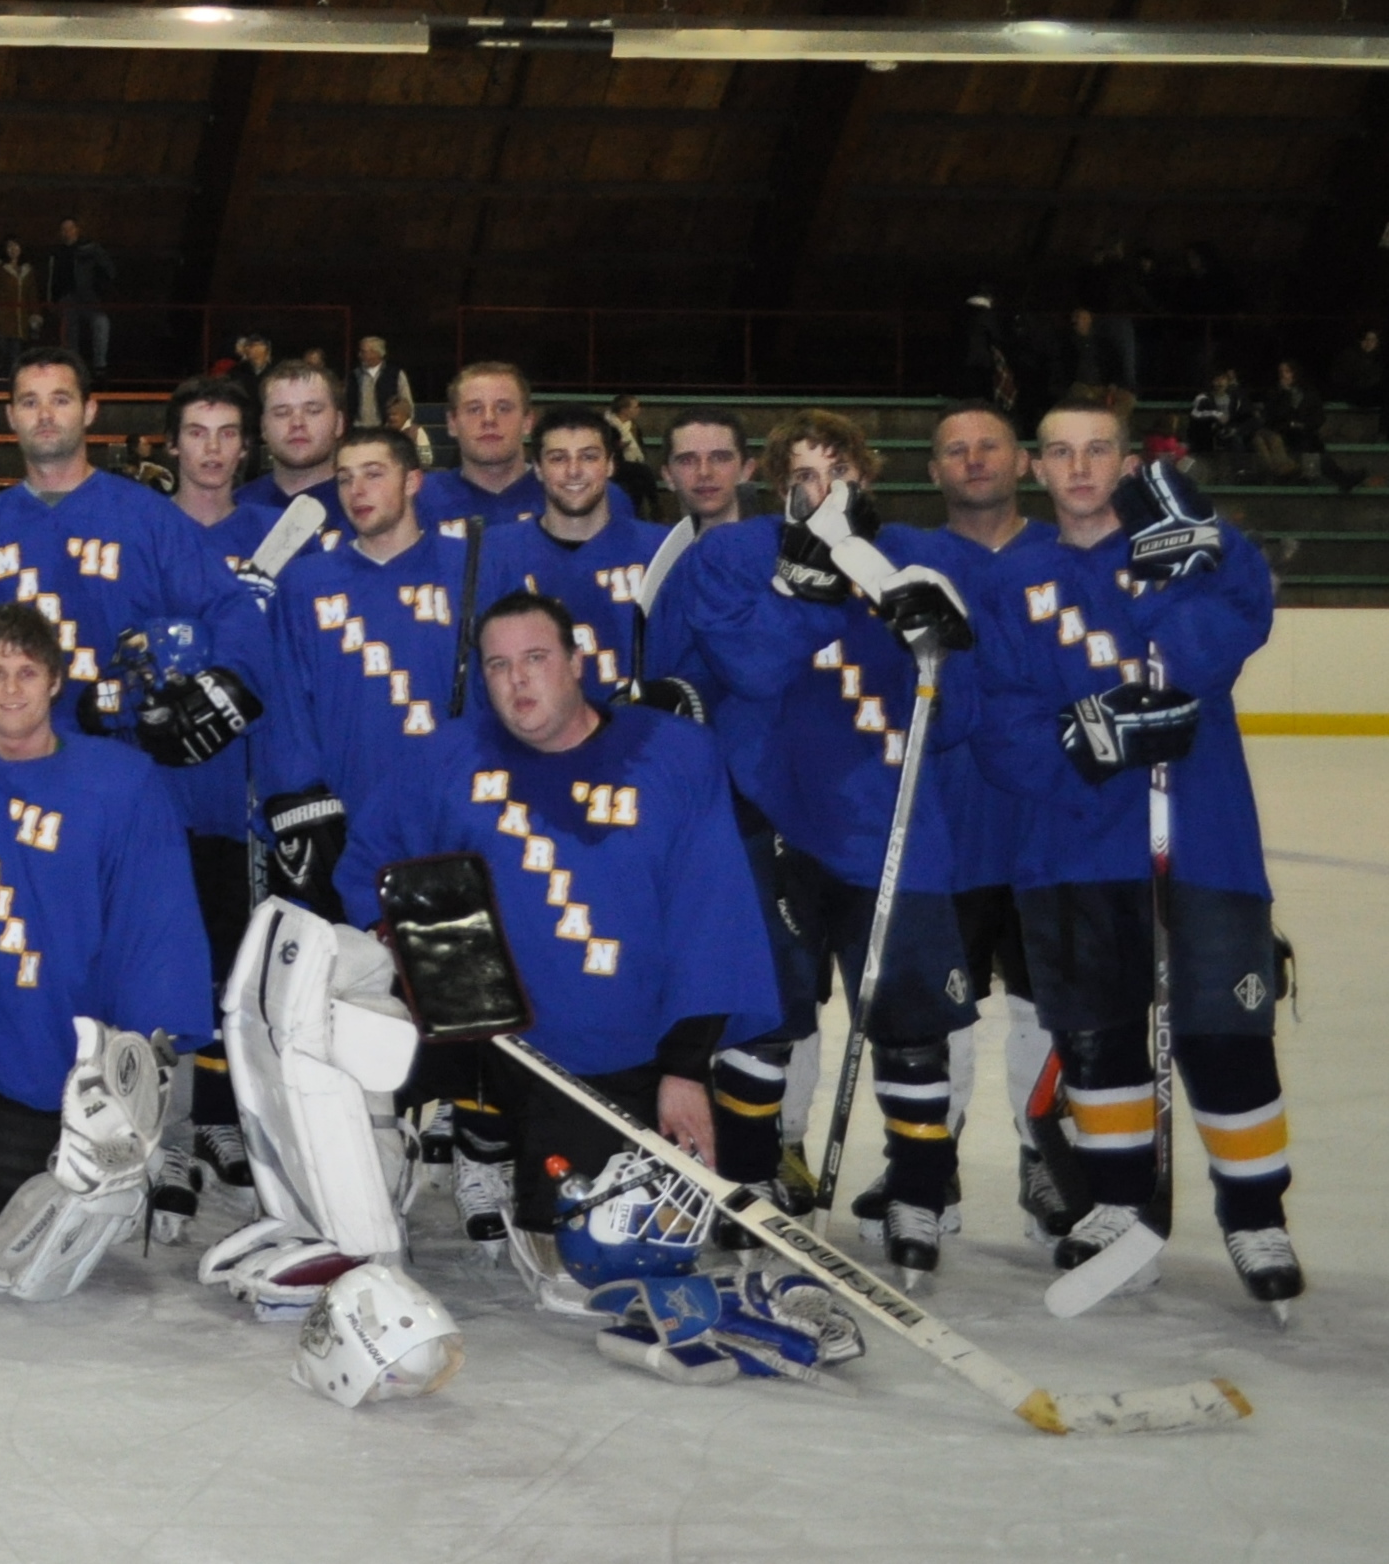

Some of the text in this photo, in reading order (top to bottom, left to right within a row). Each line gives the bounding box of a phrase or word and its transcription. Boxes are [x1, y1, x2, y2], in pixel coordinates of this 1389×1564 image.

[67, 538, 120, 580] '11
[1025, 581, 1142, 683] MARI
[314, 593, 435, 736] MARIA
[195, 671, 246, 733] ASTO
[9, 798, 63, 852] '11
[572, 781, 639, 826] '11
[472, 771, 621, 977] MARIAN
